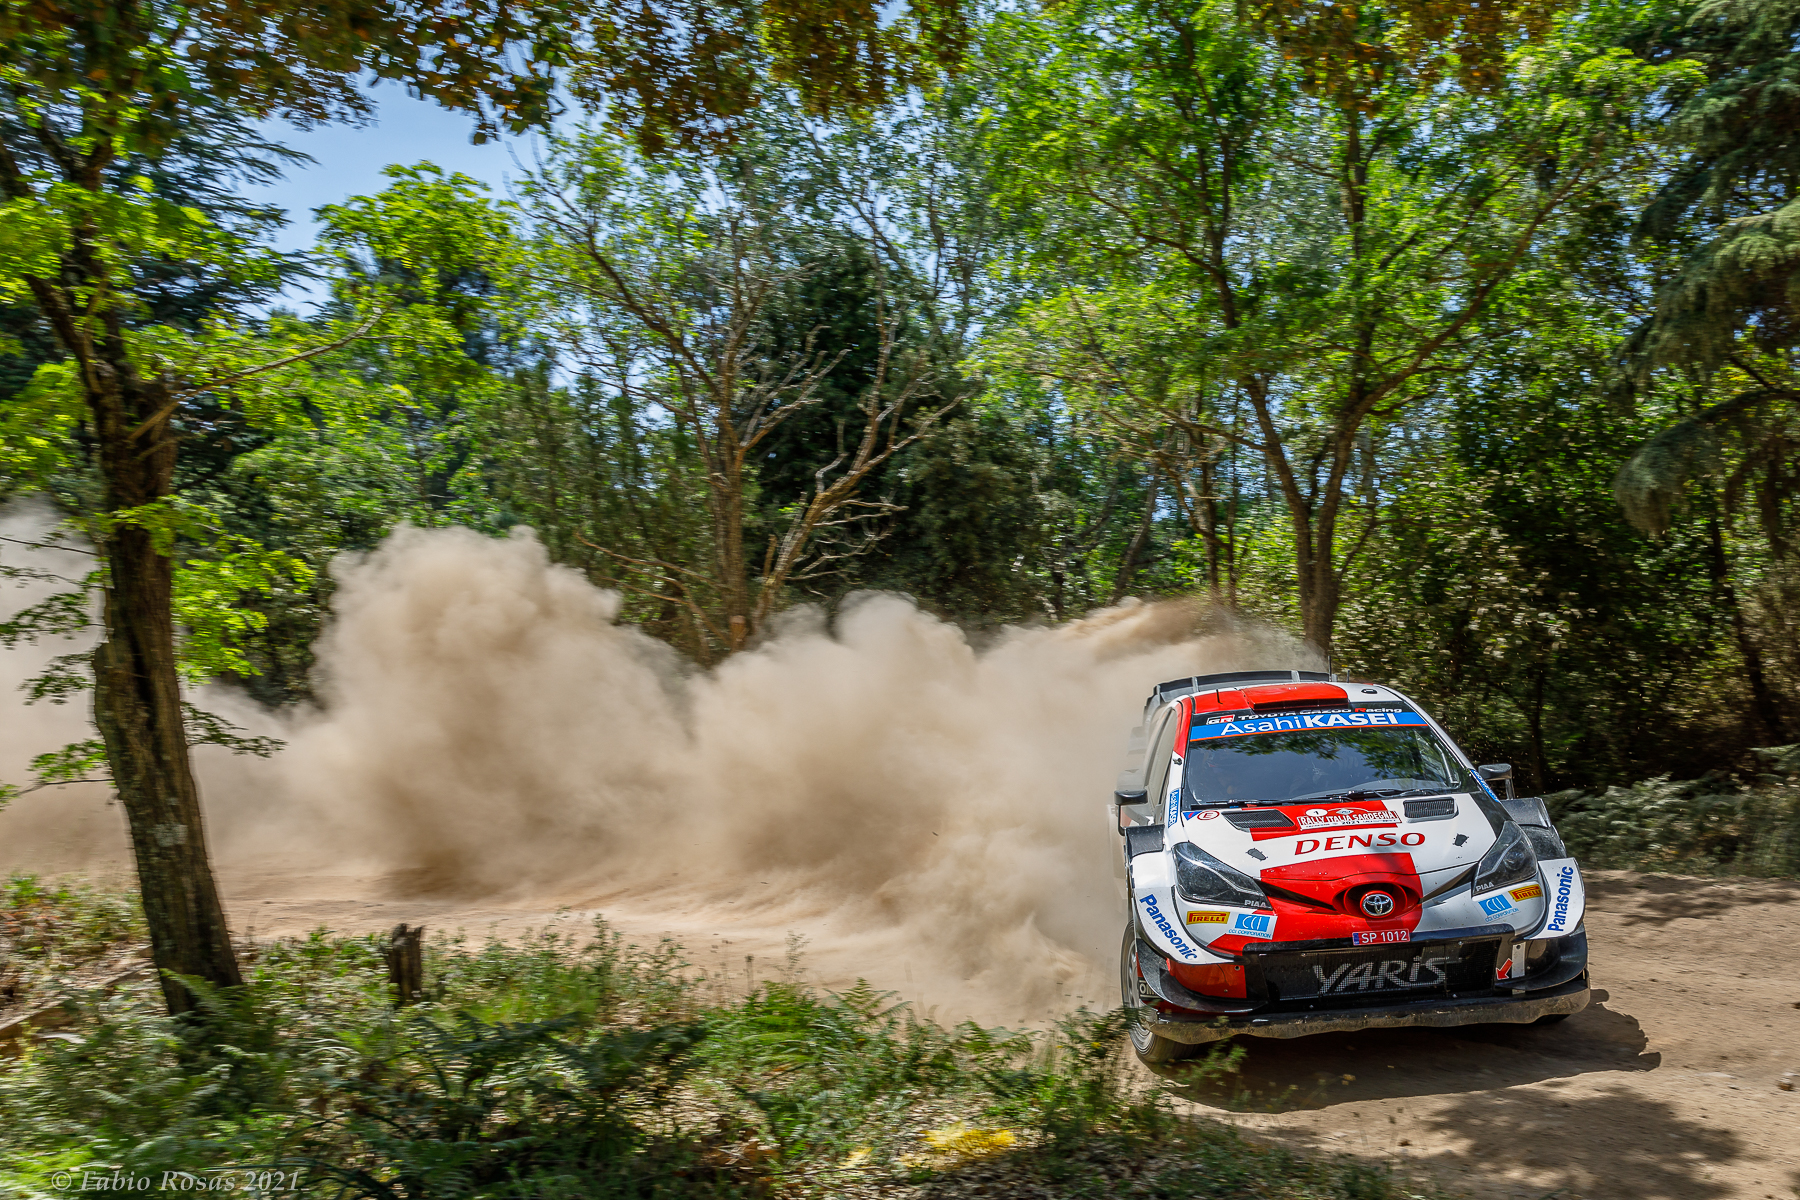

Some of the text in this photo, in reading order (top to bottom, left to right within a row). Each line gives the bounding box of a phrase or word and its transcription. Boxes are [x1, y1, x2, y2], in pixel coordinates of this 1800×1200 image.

[1221, 713, 1398, 735] AsahiKASEI
[1300, 816, 1325, 825] RALLY
[1326, 814, 1351, 823] ITALIA
[1353, 810, 1395, 820] SARDEGNA
[1294, 832, 1426, 856] DENSO
[1475, 881, 1494, 892] PIAA
[1244, 899, 1267, 908] PIAA
[1547, 866, 1574, 931] Panasonic
[1188, 912, 1227, 923] PIRELLI
[1139, 893, 1198, 960] Panasonic
[1361, 930, 1407, 944] SP 1012
